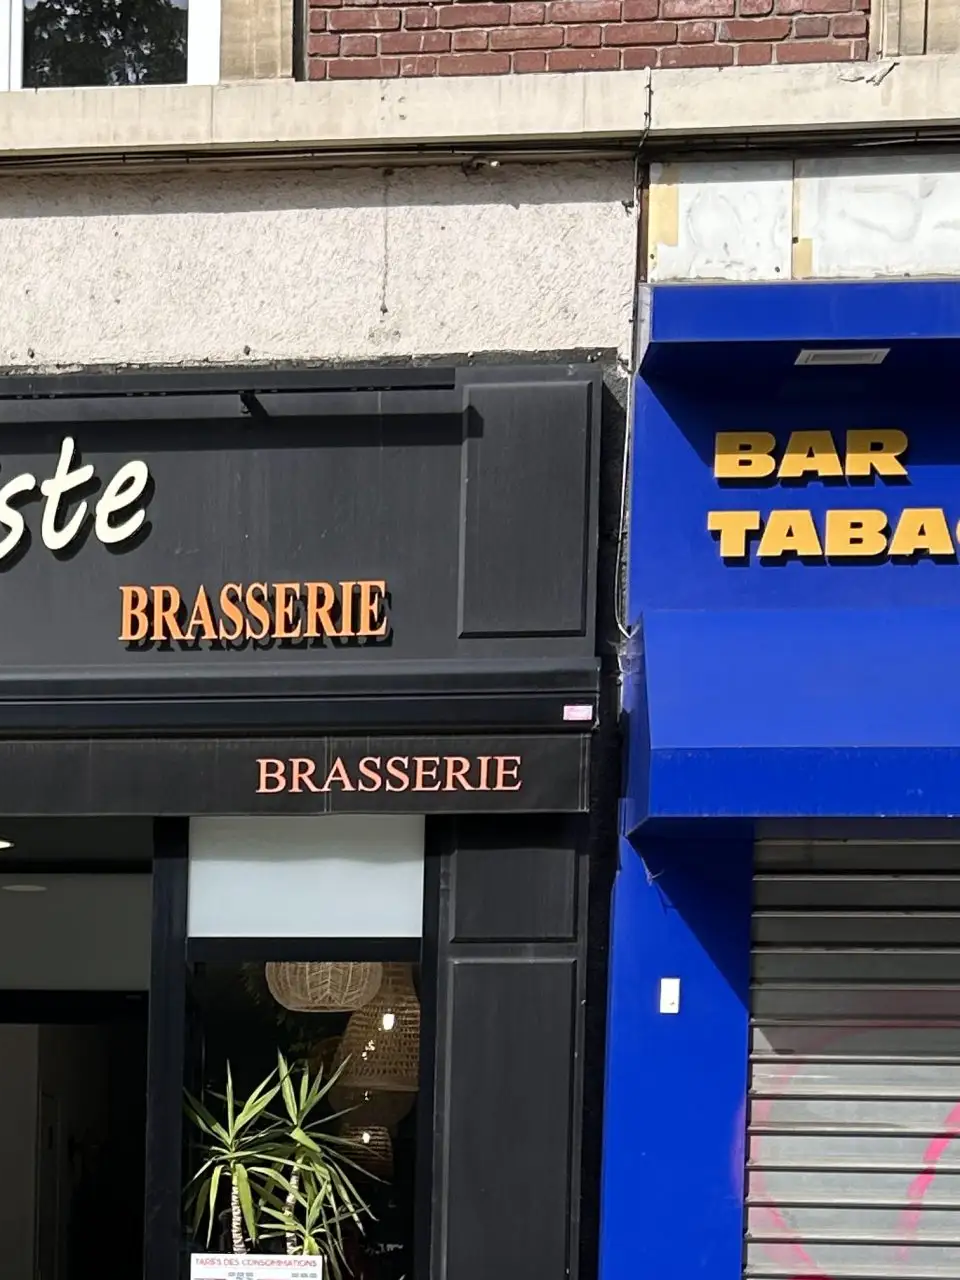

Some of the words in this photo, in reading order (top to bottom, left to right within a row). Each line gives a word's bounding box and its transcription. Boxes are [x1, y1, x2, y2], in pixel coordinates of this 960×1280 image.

[713, 429, 908, 478] BAR
[707, 508, 960, 558] TABA
[118, 579, 388, 642] BRASSERIE
[255, 756, 523, 793] BRASSERIE
